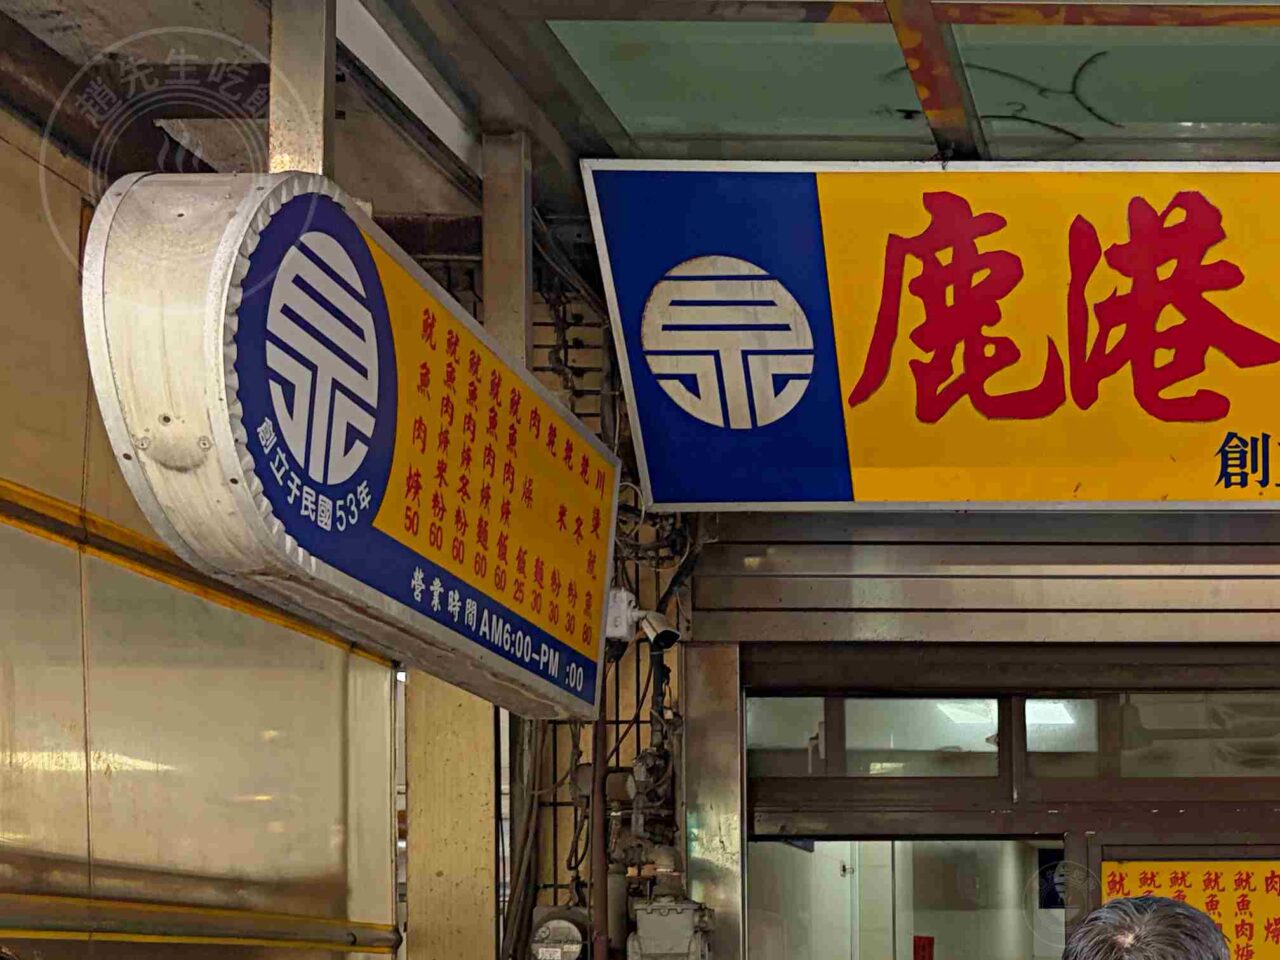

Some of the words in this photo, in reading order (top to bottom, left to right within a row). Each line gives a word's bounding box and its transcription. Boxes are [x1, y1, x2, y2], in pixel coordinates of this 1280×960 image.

[404, 505, 420, 537] 50
[428, 522, 443, 551] 60
[451, 536, 465, 565] 60
[474, 552, 487, 579] 60
[495, 566, 506, 593] 60
[513, 579, 525, 604] 25
[531, 590, 542, 615] 30
[548, 603, 560, 626] 30
[565, 614, 576, 636] 30
[582, 622, 593, 646] 80
